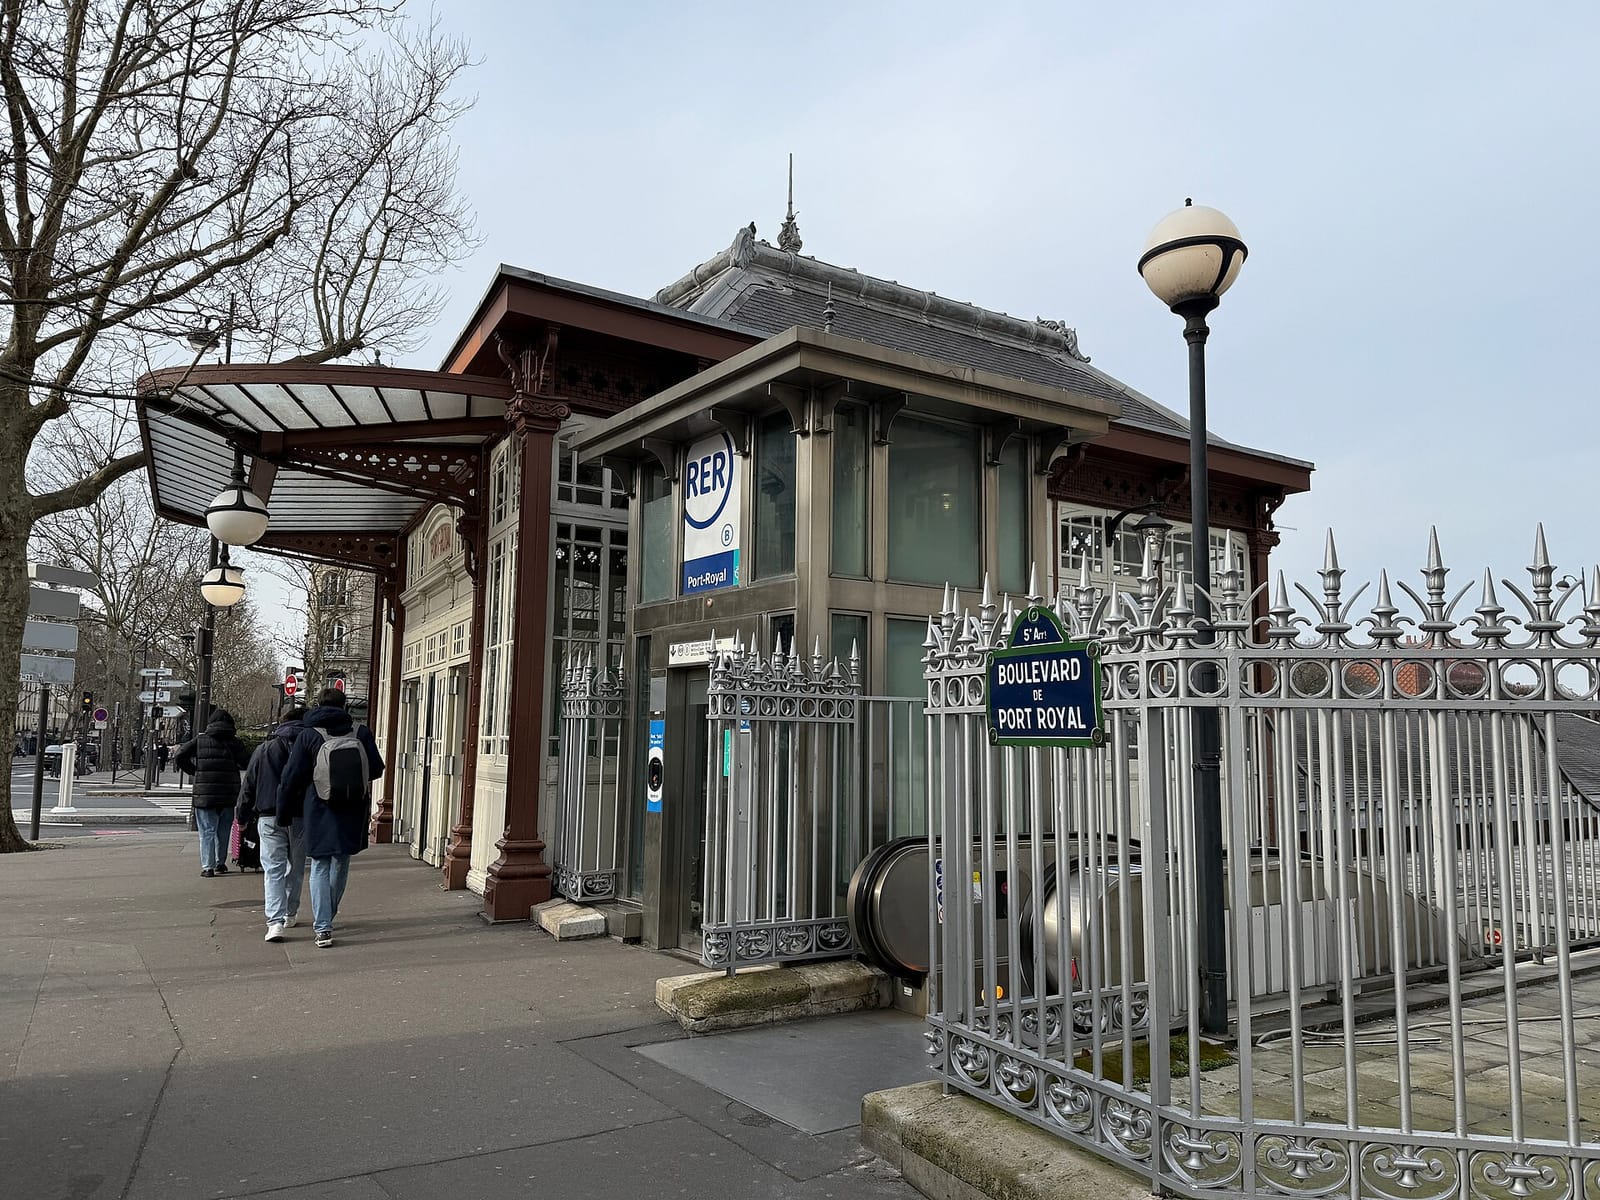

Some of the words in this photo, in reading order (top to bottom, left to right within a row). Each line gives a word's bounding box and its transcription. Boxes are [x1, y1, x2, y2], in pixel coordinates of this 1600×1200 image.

[686, 452, 726, 500] RER
[687, 568, 727, 589] Port-Royal
[998, 657, 1081, 685] BOULEVARD
[1032, 689, 1044, 701] DE
[998, 707, 1033, 730] PORT
[1037, 706, 1087, 730] ROYAL
